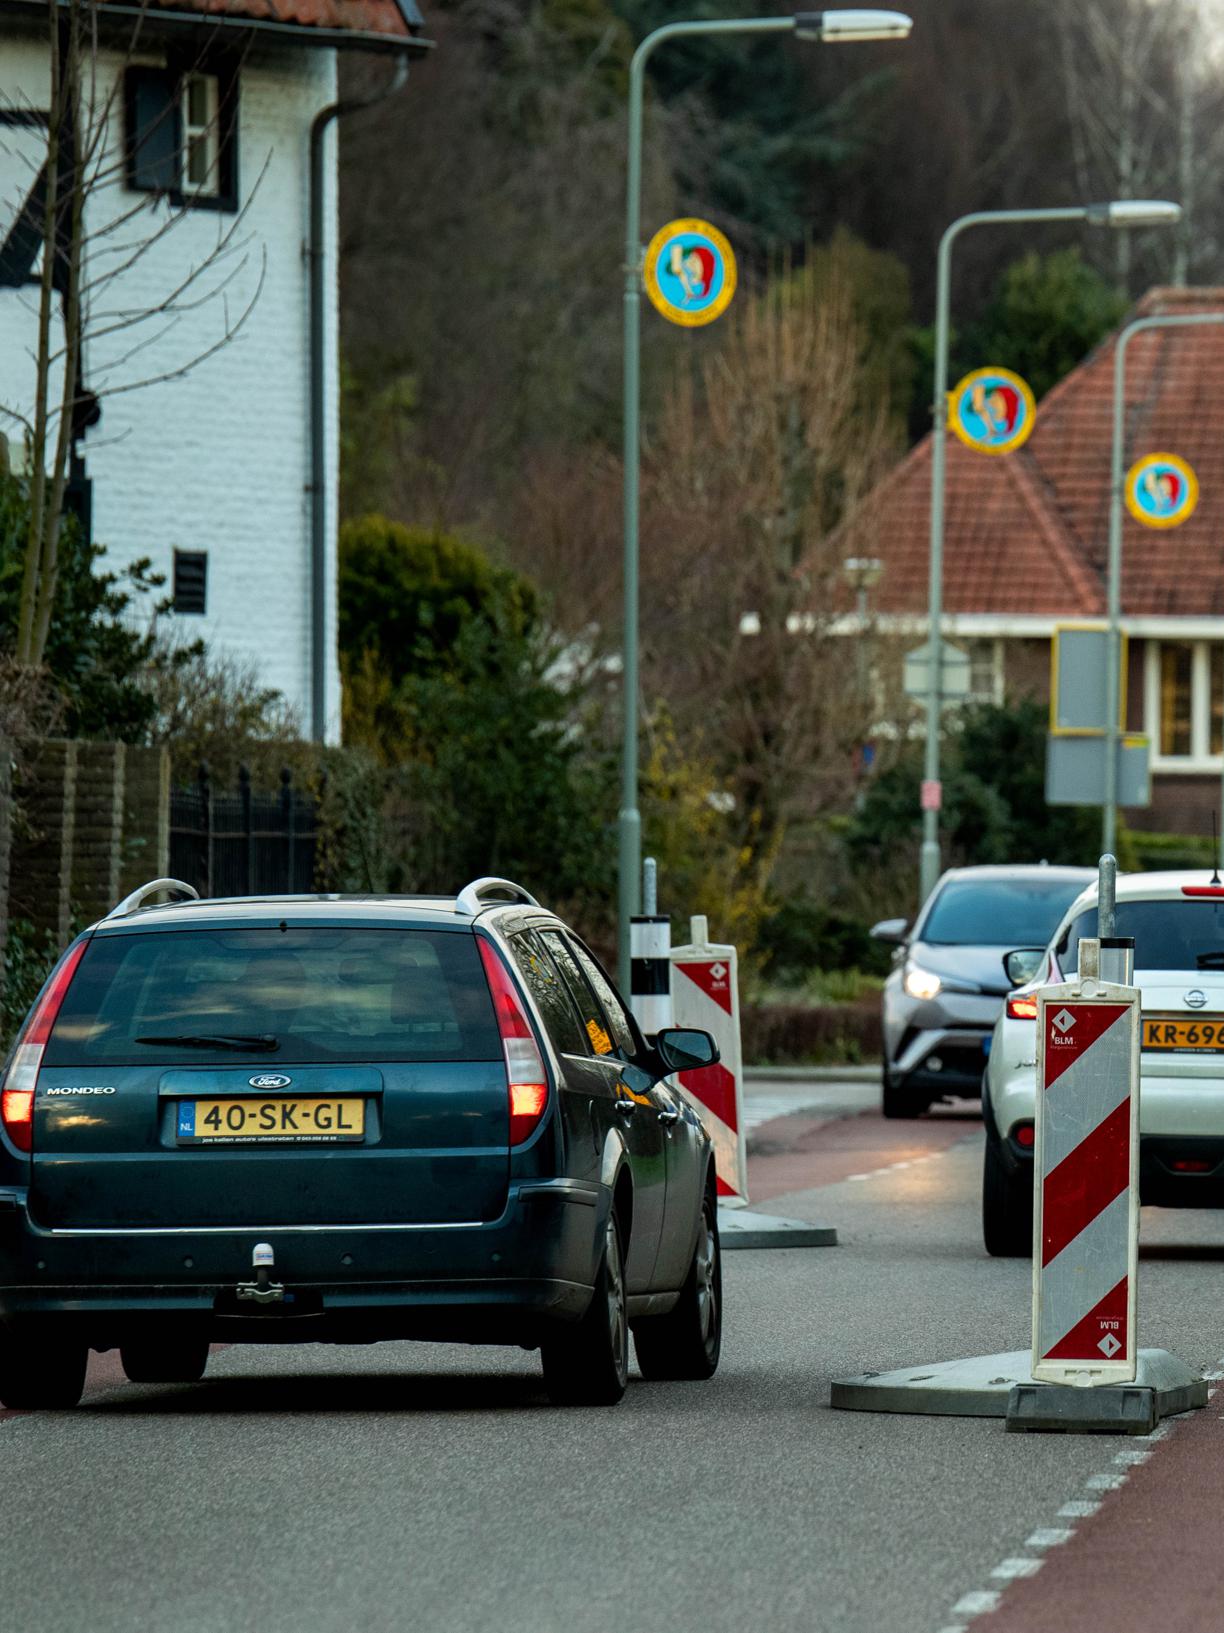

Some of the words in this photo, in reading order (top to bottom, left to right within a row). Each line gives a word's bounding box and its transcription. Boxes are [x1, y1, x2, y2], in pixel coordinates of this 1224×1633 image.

[1054, 1036, 1074, 1045] BLM
[47, 1086, 116, 1095] MONDEO
[203, 1103, 353, 1131] 40-SK-GL
[179, 1122, 193, 1131] NL
[1100, 1320, 1119, 1329] BLM
